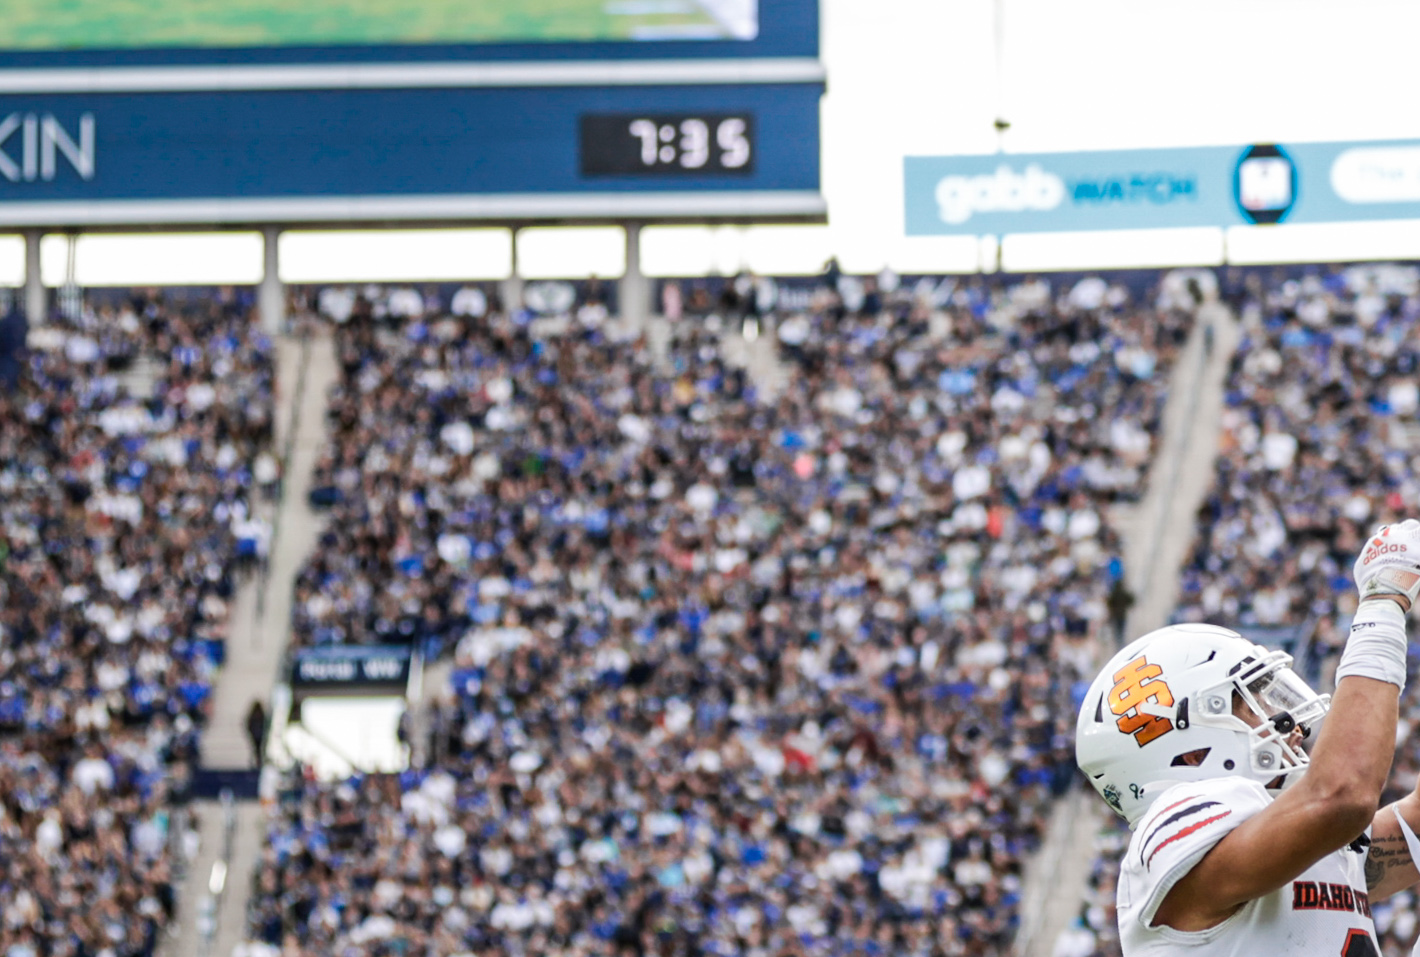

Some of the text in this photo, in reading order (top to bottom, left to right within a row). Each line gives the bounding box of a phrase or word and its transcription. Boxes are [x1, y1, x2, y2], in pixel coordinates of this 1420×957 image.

[628, 117, 750, 169] 7:35
[934, 162, 1198, 225] gabb WATCH
[1363, 543, 1408, 566] adidas
[1292, 881, 1355, 911] IDAHO
